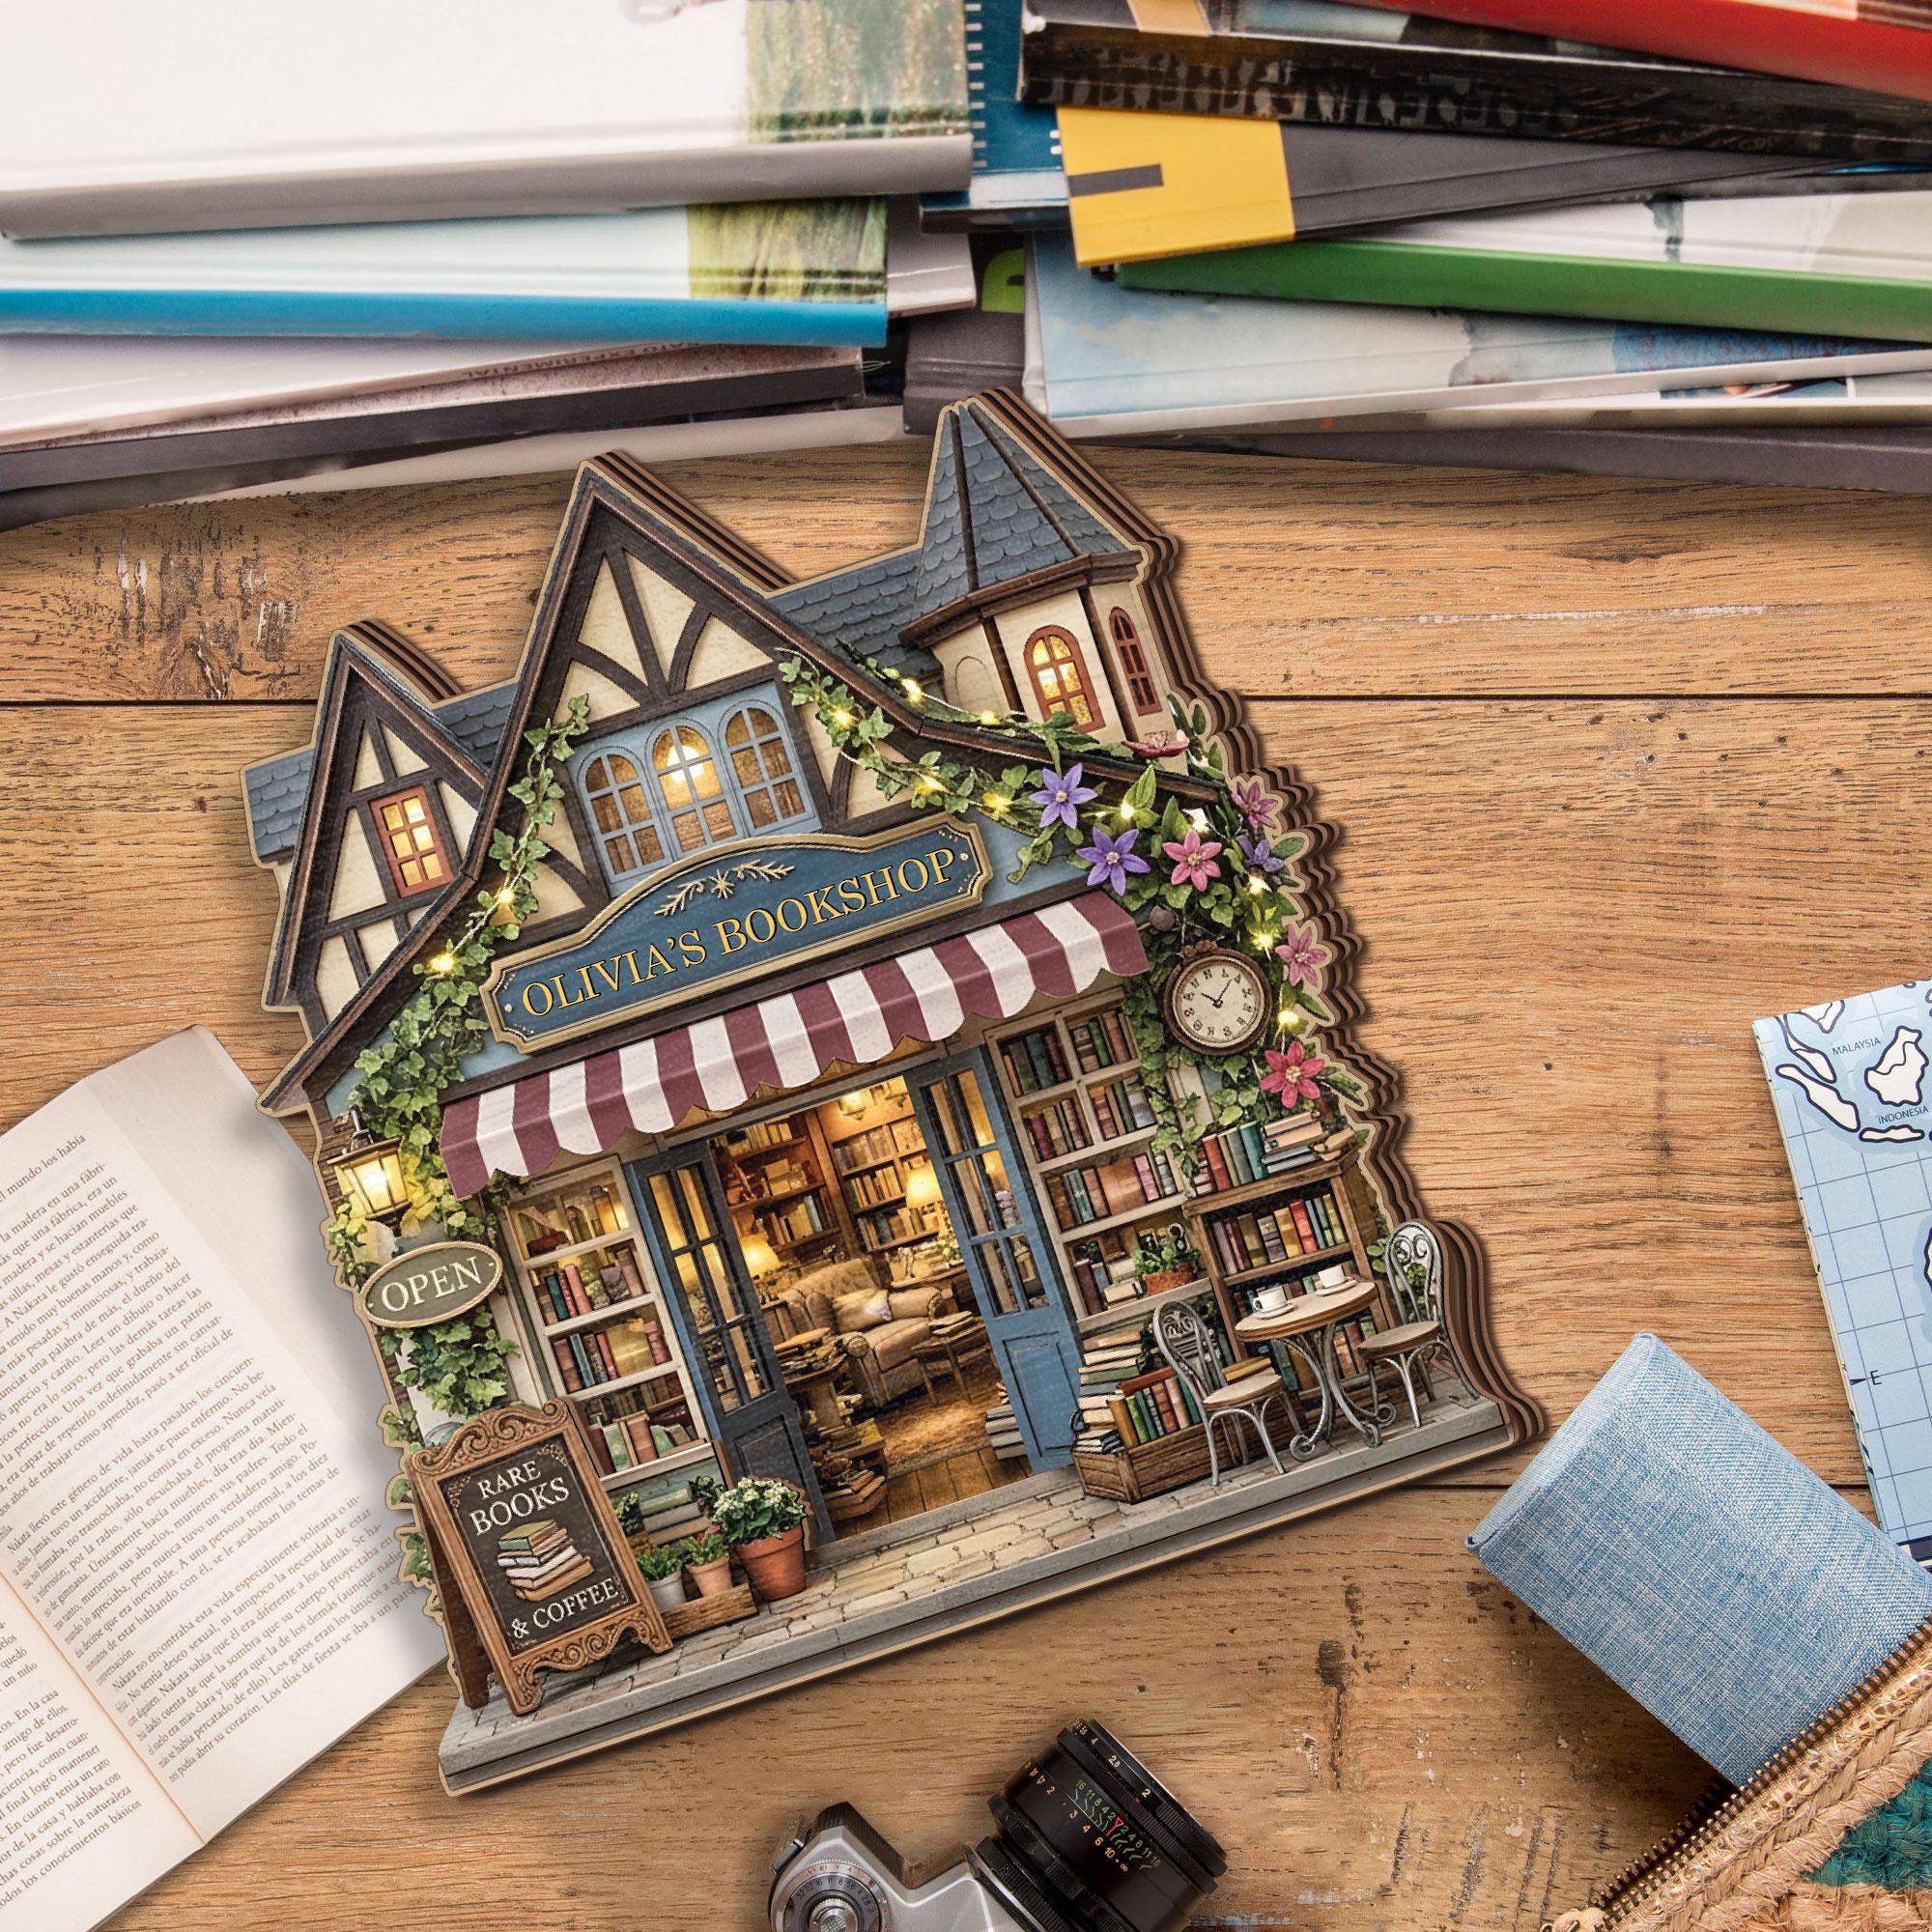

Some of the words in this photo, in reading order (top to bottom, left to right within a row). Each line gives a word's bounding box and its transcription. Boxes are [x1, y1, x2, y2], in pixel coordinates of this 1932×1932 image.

[522, 929, 707, 1017] OLIVIA'S
[712, 847, 958, 956] BOOKSHOP
[1832, 1037, 1882, 1056] MALAYSIA
[1877, 1105, 1929, 1124] INDONESIA
[7, 1166, 42, 1195] mundo
[40, 1154, 58, 1168] los
[55, 1135, 85, 1157] había
[11, 1206, 47, 1235] madera
[46, 1196, 61, 1208] en
[60, 1181, 80, 1198] una
[78, 1161, 105, 1184] fábri-
[3, 1256, 38, 1284] madera
[44, 1242, 56, 1253] se
[53, 1218, 88, 1245] hacían
[85, 1190, 128, 1221] muebles
[8, 1281, 36, 1302] sillas,
[34, 1258, 63, 1283] mesas
[71, 1217, 120, 1255] estanterías
[119, 1204, 138, 1220] que
[12, 1239, 31, 1256] que
[30, 1224, 50, 1241] una
[49, 1201, 87, 1227] fábrica,
[86, 1186, 102, 1201] era
[101, 1177, 117, 1189] un
[6, 1322, 37, 1348] tenido
[36, 1304, 58, 1324] muy
[55, 1281, 91, 1308] buenas
[90, 1258, 122, 1284] manos
[121, 1252, 133, 1264] y,
[131, 1232, 159, 1254] como
[6, 1351, 26, 1371] más
[25, 1324, 62, 1357] pesadas
[70, 1279, 128, 1321] minuciosas,
[133, 1246, 168, 1273] trabaja-
[11, 1292, 47, 1321] Nakata
[45, 1284, 58, 1294] le
[58, 1262, 84, 1289] gustó
[84, 1230, 131, 1266] enseguida
[130, 1218, 147, 1233] tra-
[382, 1255, 480, 1314] OPEN
[28, 1357, 48, 1375] una
[47, 1330, 83, 1362] palabra
[84, 1320, 97, 1332] de
[98, 1304, 122, 1322] más,
[121, 1292, 131, 1304] el
[132, 1271, 163, 1296] dueño
[164, 1256, 181, 1273] del
[2, 1453, 14, 1463] la
[13, 1414, 63, 1457] perfección.
[61, 1395, 85, 1413] Una
[86, 1381, 102, 1395] vez
[105, 1365, 124, 1382] que
[125, 1336, 163, 1370] grababa
[163, 1325, 179, 1338] un
[180, 1300, 213, 1329] patrón
[1870, 1369, 1883, 1385] E
[6, 1530, 31, 1554] Nakata
[27, 1512, 49, 1533] llevó
[49, 1498, 67, 1516] este
[67, 1474, 98, 1503] género
[99, 1463, 111, 1476] de
[111, 1446, 133, 1463] vida
[131, 1427, 158, 1448] hasta
[158, 1398, 197, 1432] pasados
[195, 1386, 213, 1400] los
[213, 1357, 253, 1388] cincuen-
[477, 1461, 542, 1500] RARE
[46, 1600, 59, 1610] de
[57, 1573, 91, 1605] gimnasia.
[88, 1527, 143, 1573] Únicamente
[140, 1506, 169, 1529] hacía
[169, 1477, 213, 1510] muebles,
[209, 1463, 229, 1477] día
[228, 1448, 247, 1464] tras
[248, 1435, 267, 1450] día.
[265, 1412, 296, 1435] Mien-
[79, 1616, 91, 1627] lo
[90, 1585, 131, 1620] apreciaba,
[129, 1566, 151, 1587] pero
[152, 1542, 182, 1568] nunca
[181, 1524, 204, 1544] tuvo
[204, 1513, 220, 1526] un
[219, 1477, 267, 1514] verdadero
[269, 1454, 301, 1479] amigo.
[298, 1440, 317, 1454] Po-
[469, 1476, 570, 1536] BOOKS
[111, 1668, 137, 1691] Nakata
[135, 1660, 147, 1672] no
[147, 1621, 195, 1662] encontraba
[194, 1606, 213, 1623] esta
[213, 1590, 234, 1607] vida
[235, 1541, 299, 1592] especialmente
[299, 1513, 338, 1542] solitaria
[344, 1495, 358, 1508] in-
[157, 1670, 189, 1696] Nakata
[188, 1652, 212, 1672] sabía
[212, 1637, 230, 1655] que
[230, 1627, 240, 1640] él
[240, 1618, 255, 1632] era
[255, 1586, 297, 1620] diferente
[301, 1570, 319, 1583] los
[320, 1547, 353, 1572] demás.
[351, 1535, 365, 1547] Se
[363, 1524, 380, 1537] ha-
[511, 1618, 529, 1639] &
[532, 1577, 620, 1629] COFFEE
[3, 1752, 26, 1774] pero
[25, 1740, 44, 1755] fue
[44, 1718, 77, 1743] desarro-
[5, 1790, 31, 1812] final
[28, 1771, 57, 1796] logró
[57, 1744, 99, 1776] mantener
[45, 1826, 73, 1849] sobre
[71, 1817, 85, 1828] la
[85, 1786, 131, 1820] naturaleza
[1142, 1788, 1151, 1798] 2
